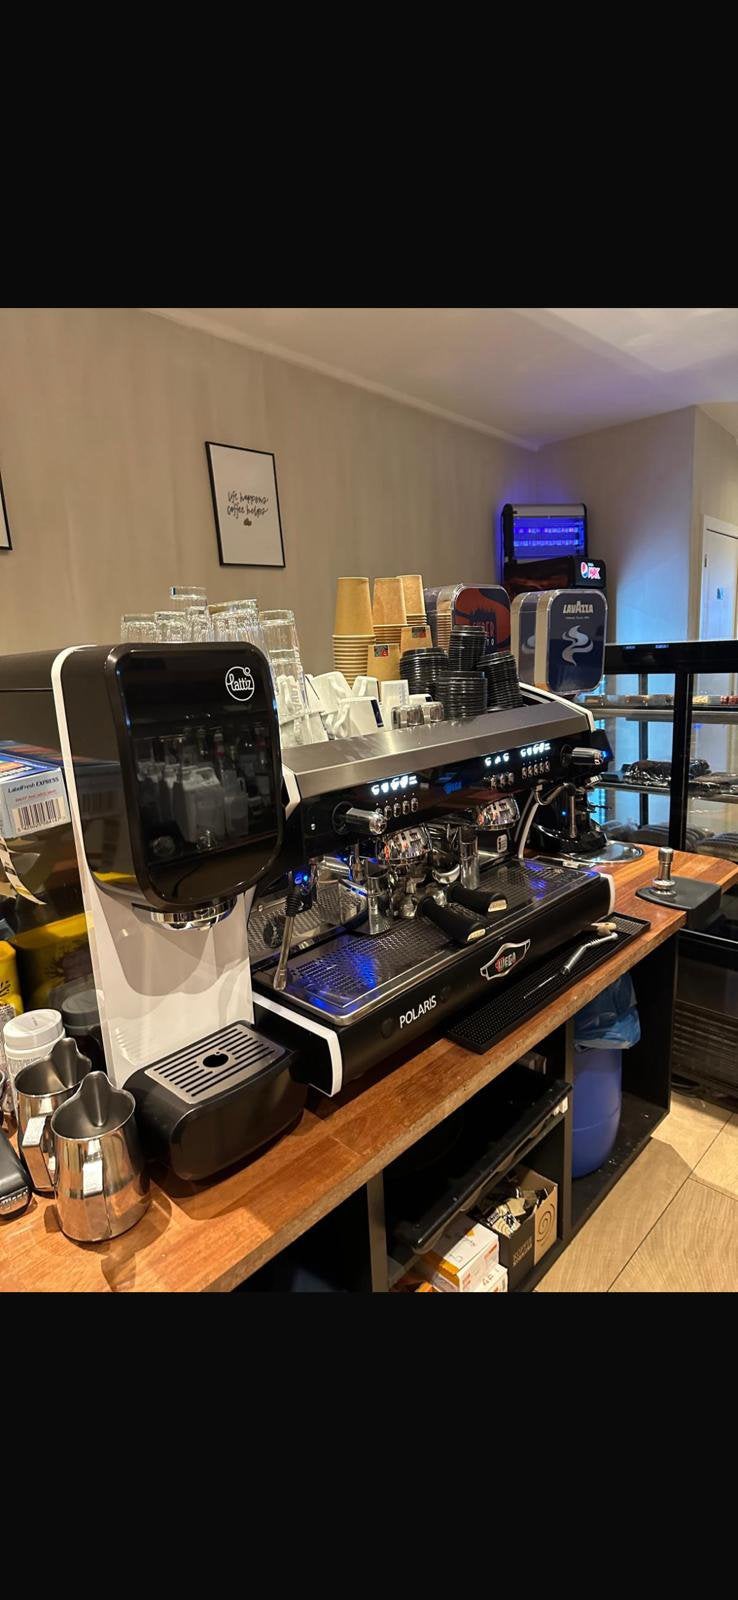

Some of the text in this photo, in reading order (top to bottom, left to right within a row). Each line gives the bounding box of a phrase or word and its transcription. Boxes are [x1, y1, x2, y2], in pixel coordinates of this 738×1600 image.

[562, 600, 594, 614] LAVAZZA
[35, 776, 60, 786] EXPRESS
[399, 994, 438, 1029] POLARIS
